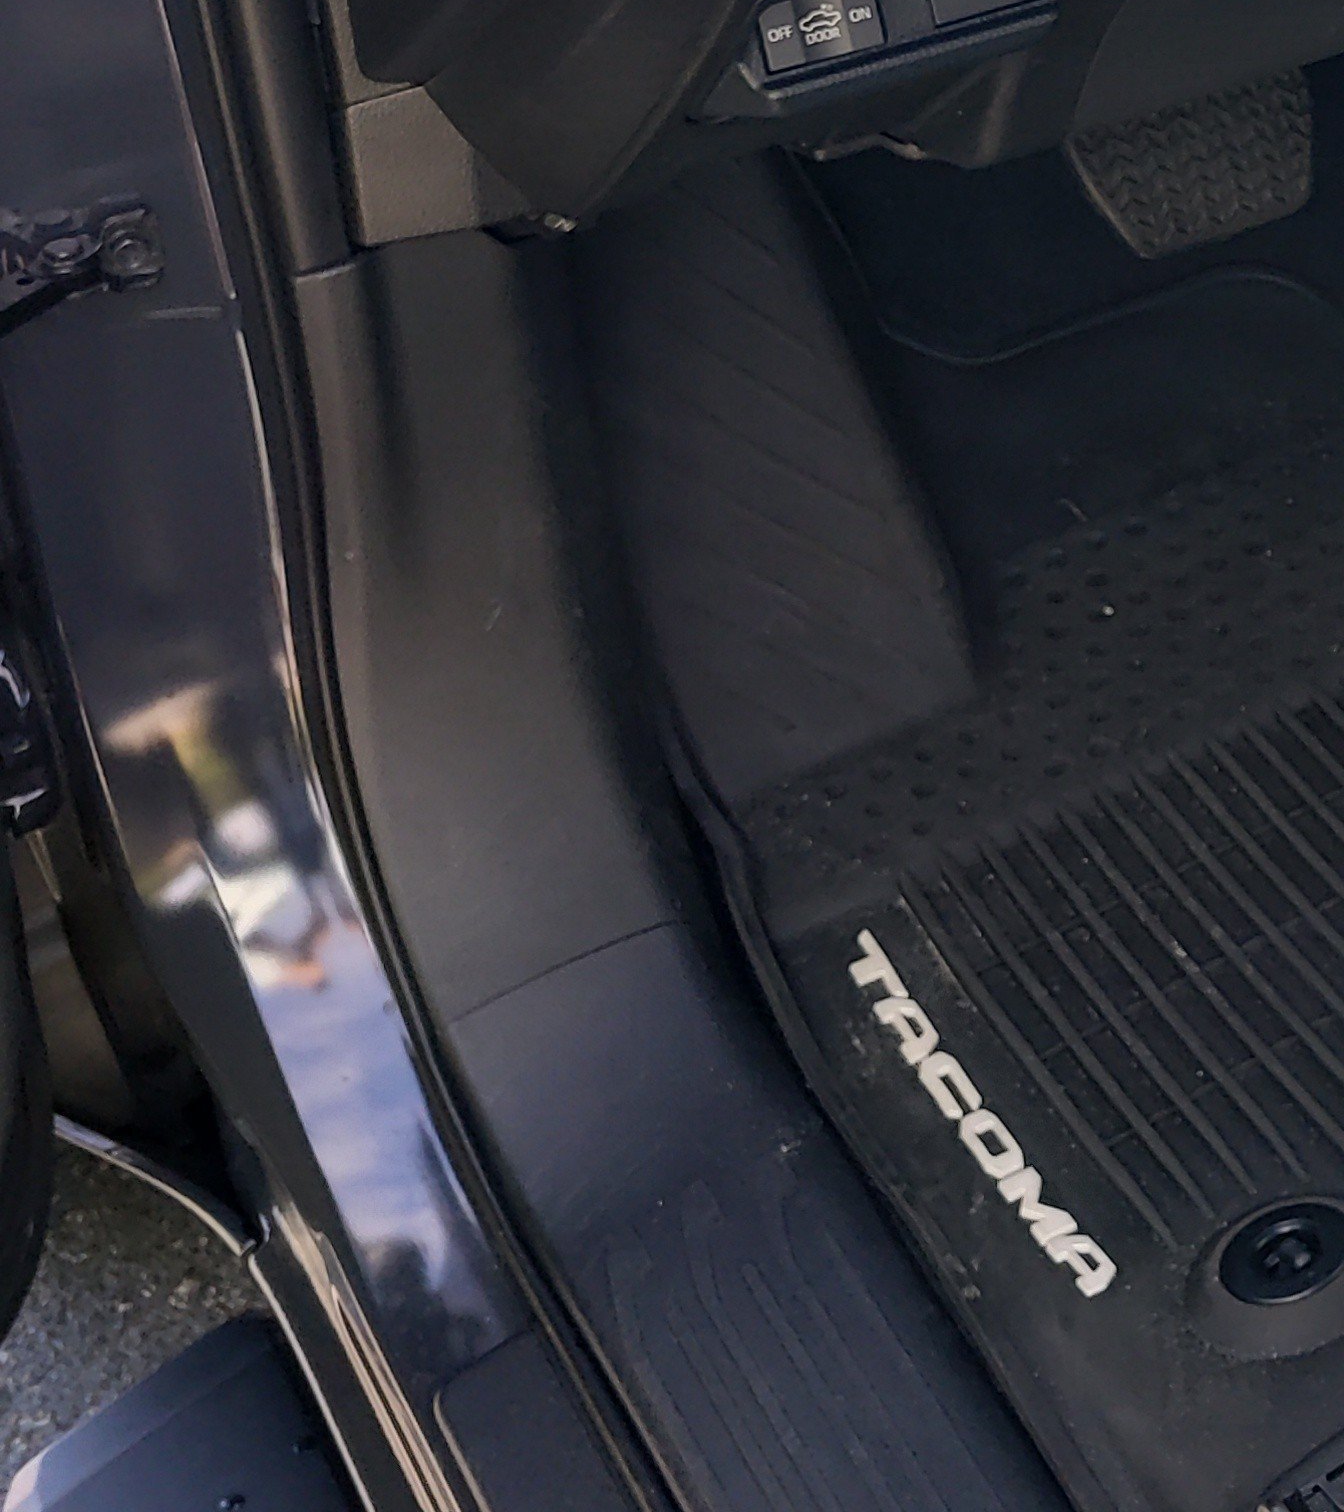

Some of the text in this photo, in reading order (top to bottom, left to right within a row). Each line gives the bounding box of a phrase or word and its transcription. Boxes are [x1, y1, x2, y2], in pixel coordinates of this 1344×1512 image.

[848, 5, 873, 23] ON
[767, 24, 794, 43] OFF
[805, 27, 842, 46] DOOR
[848, 928, 1118, 1299] TACOMA
